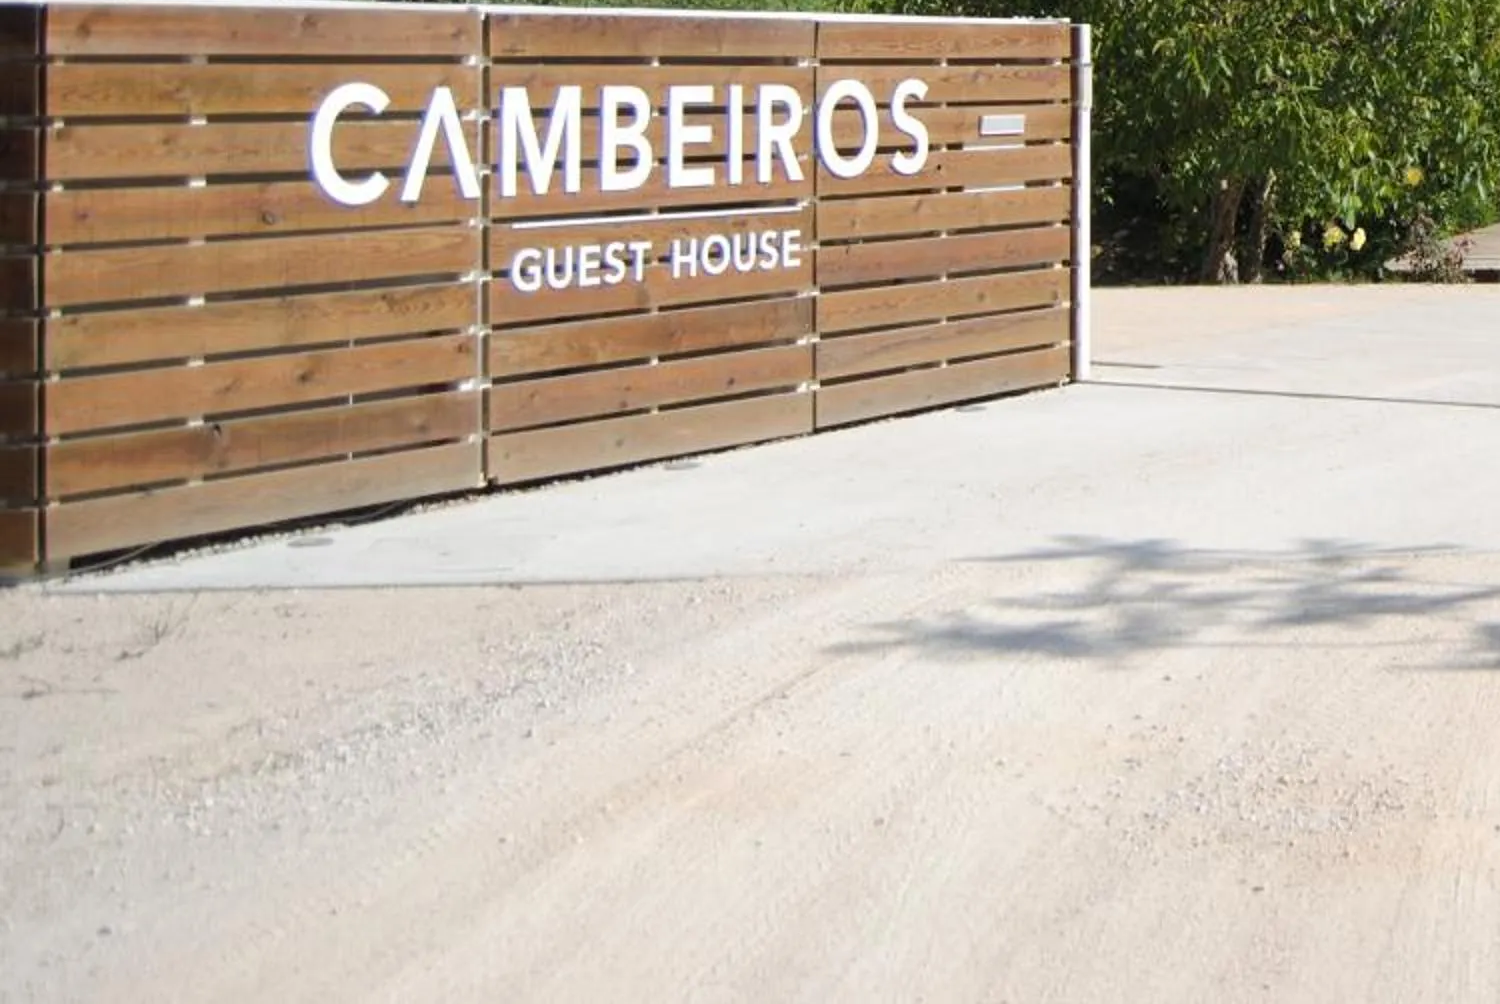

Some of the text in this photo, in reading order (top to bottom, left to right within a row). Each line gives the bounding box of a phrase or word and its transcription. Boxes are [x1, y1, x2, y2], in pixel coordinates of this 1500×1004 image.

[309, 78, 929, 205] CAMBEIROS
[511, 229, 802, 292] GUEST HOUSE
